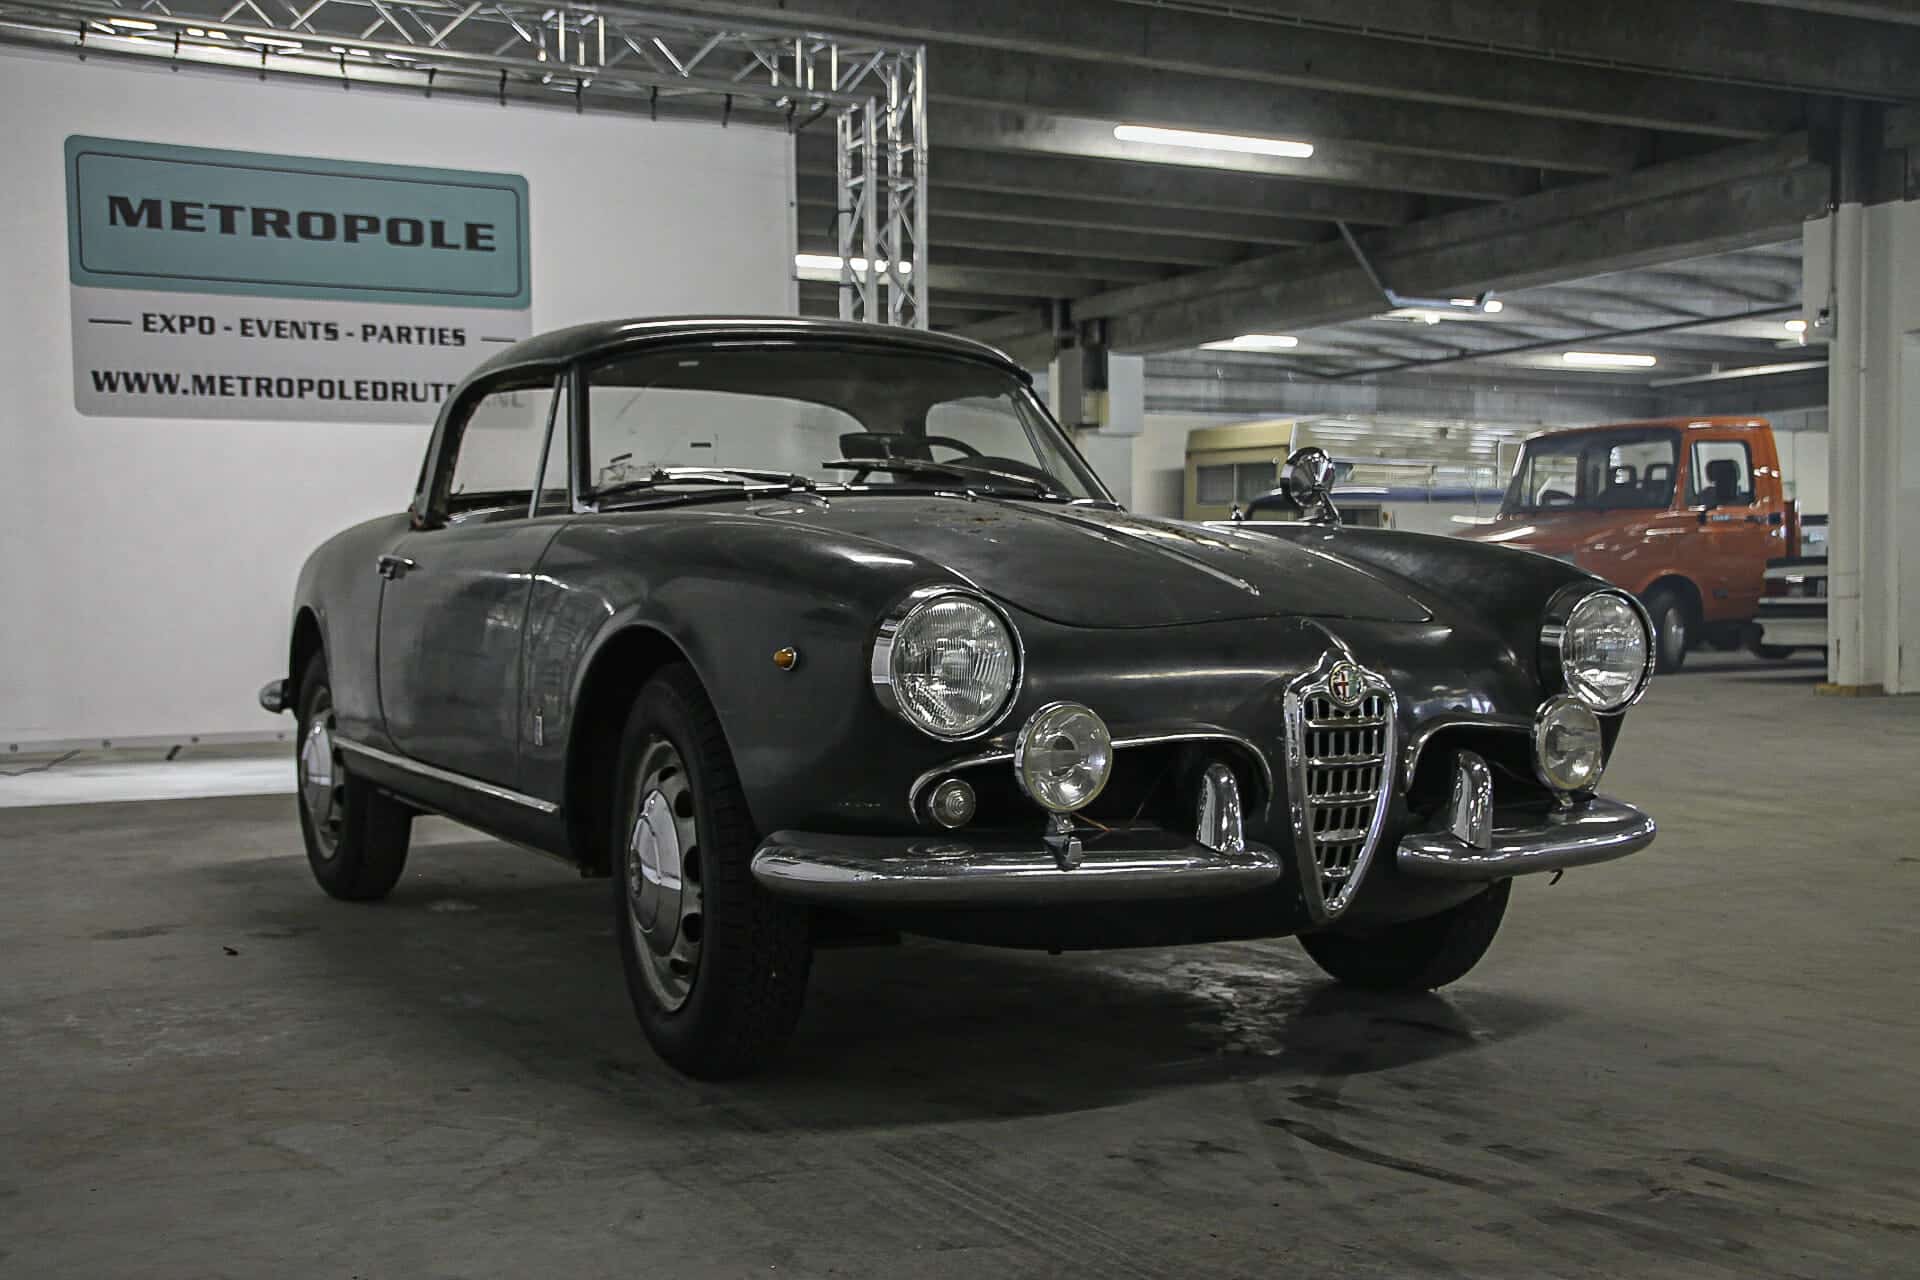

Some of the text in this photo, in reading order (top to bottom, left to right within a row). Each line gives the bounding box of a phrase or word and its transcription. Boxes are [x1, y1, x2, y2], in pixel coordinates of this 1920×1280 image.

[107, 195, 496, 252] METROPOLE
[142, 312, 216, 336] EXPO
[239, 317, 340, 342] EVENTS
[361, 324, 467, 347] PARTIES
[90, 369, 457, 404] WWW.METROPOLEDRUT
